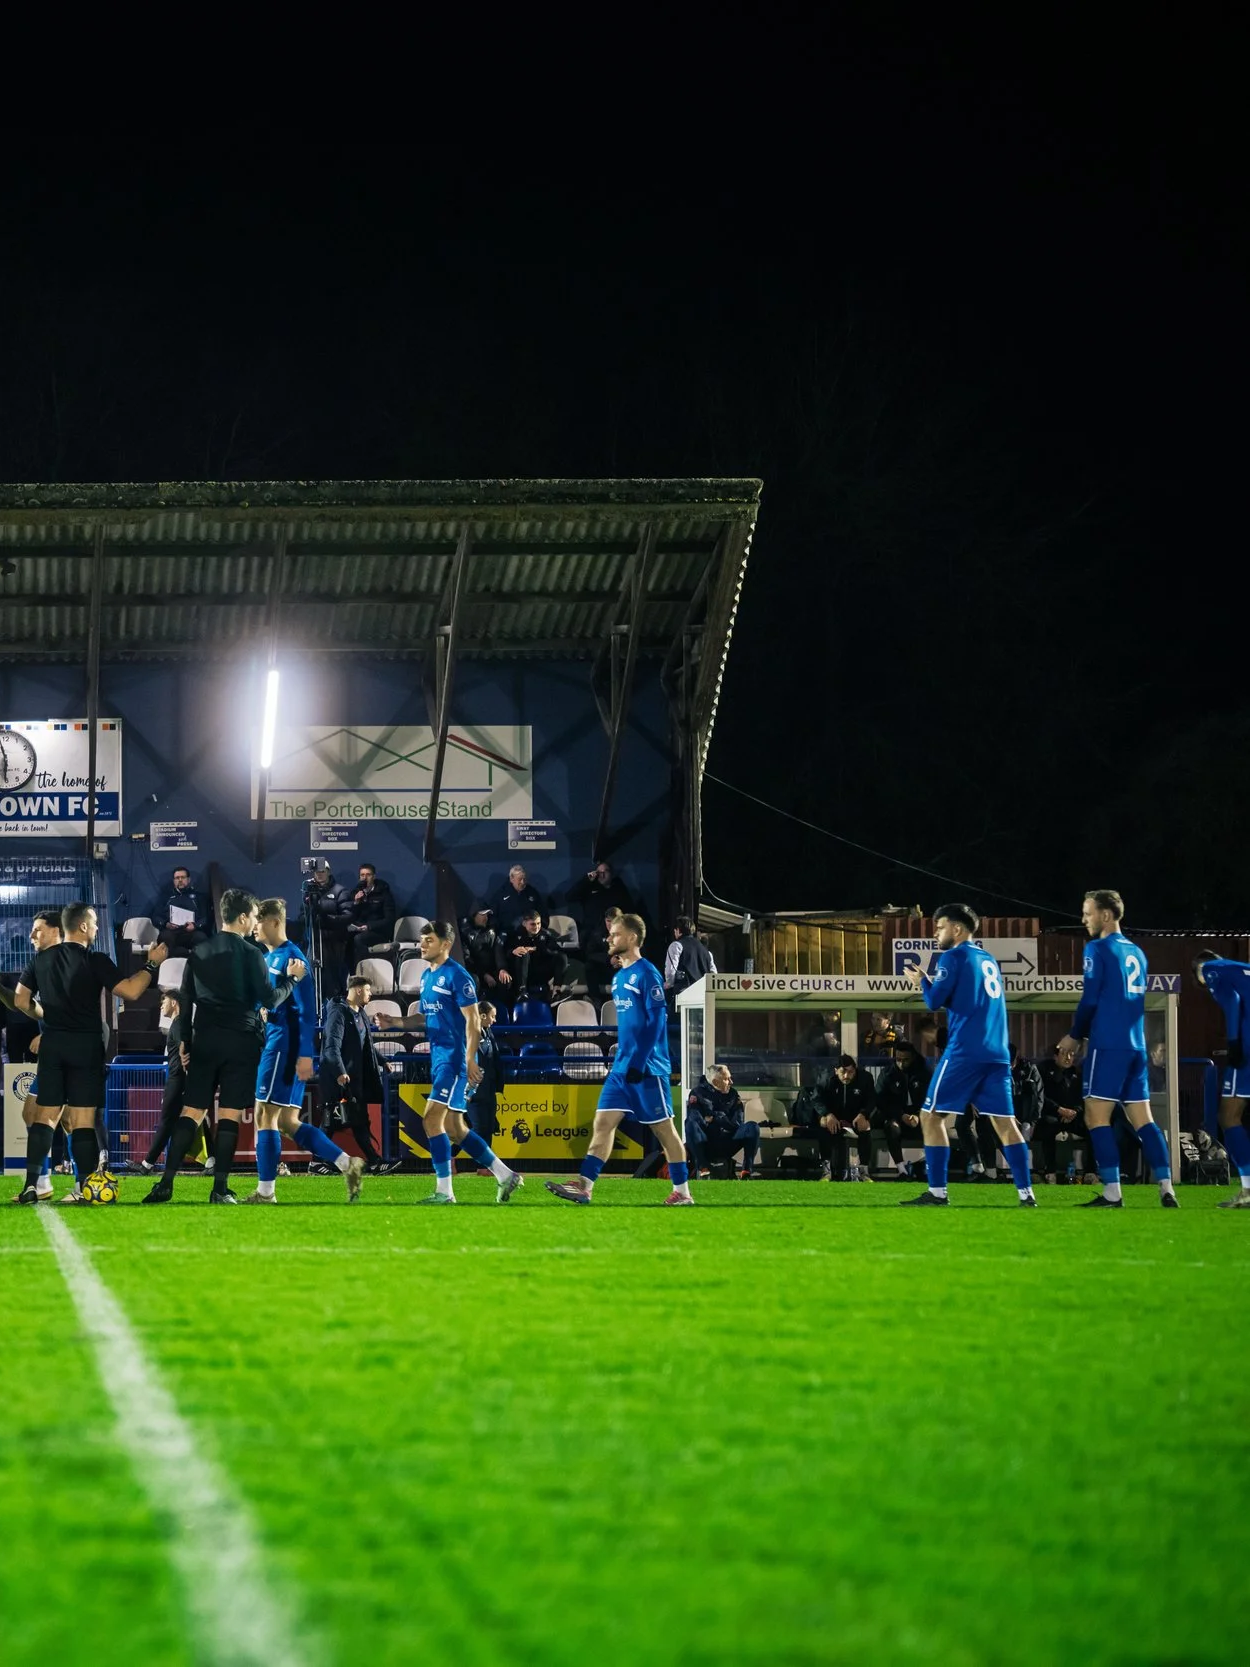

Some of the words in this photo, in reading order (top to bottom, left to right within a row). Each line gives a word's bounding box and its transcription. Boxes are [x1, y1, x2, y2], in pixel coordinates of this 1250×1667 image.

[36, 771, 57, 788] the
[62, 771, 90, 787] home
[95, 776, 107, 791] of
[68, 796, 98, 817] FC
[270, 801, 306, 817] The
[314, 801, 430, 817] Porterhouse
[437, 801, 492, 818] Stand
[5, 823, 19, 832] back
[4, 865, 14, 873] &
[895, 941, 939, 950] CORNE
[981, 960, 1001, 999] 8
[1125, 955, 1145, 993] 2
[790, 979, 855, 991] CHURCH
[868, 980, 922, 991] www.
[552, 1100, 569, 1115] by
[535, 1124, 589, 1140] League
